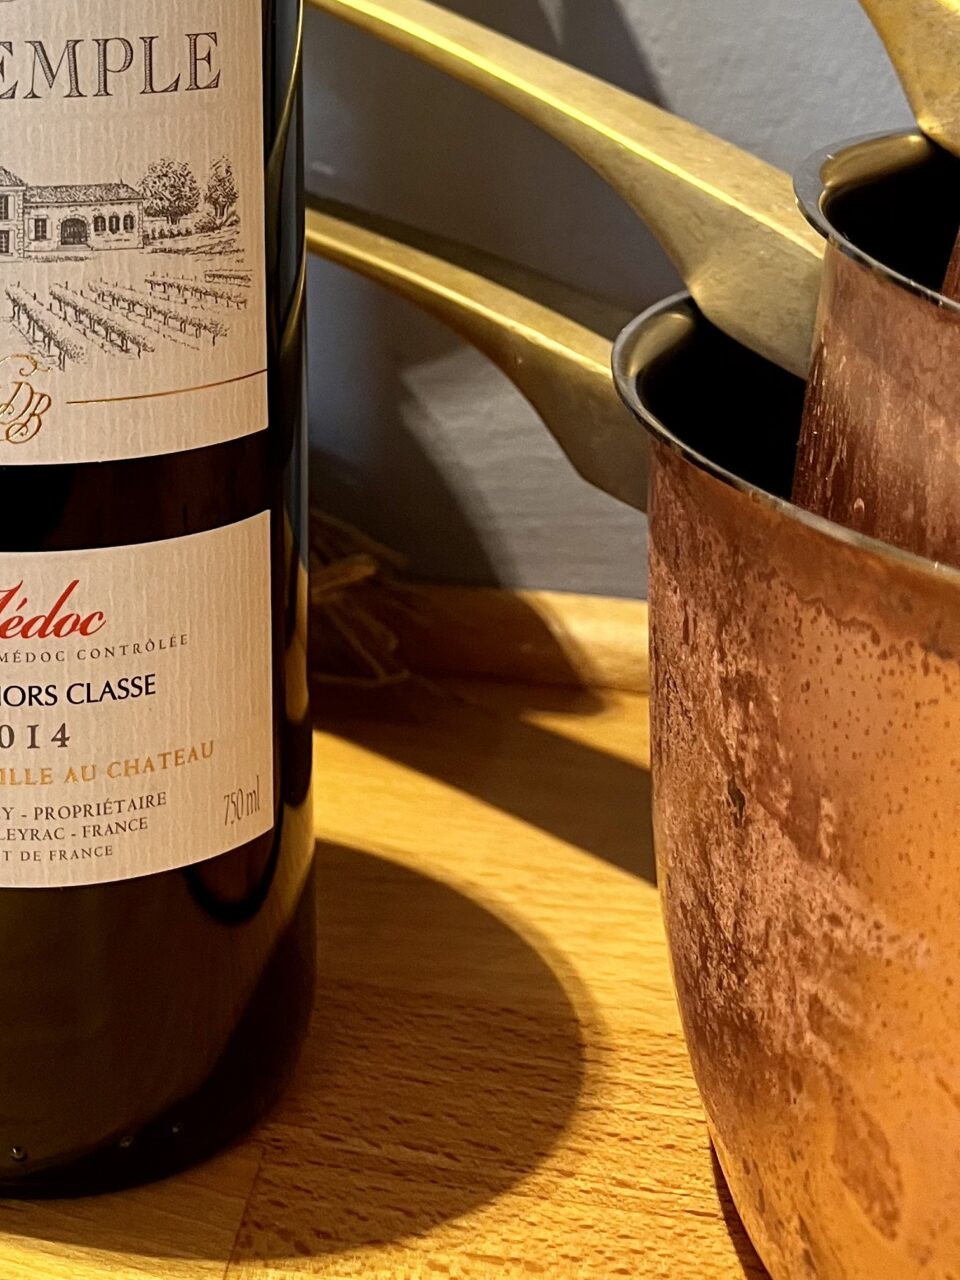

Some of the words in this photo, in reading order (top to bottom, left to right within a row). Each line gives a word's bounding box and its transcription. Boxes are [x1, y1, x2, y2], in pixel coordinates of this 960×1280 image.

[76, 633, 189, 661] CONTRÔLÉE
[66, 673, 157, 705] CLASSE
[63, 764, 97, 784] AU
[106, 739, 215, 780] CHATEAU
[34, 790, 167, 821] PROPRIÉTAIRE
[223, 786, 244, 826] 750
[246, 775, 261, 815] ml
[82, 817, 148, 839] FRANCE
[20, 851, 41, 862] DE
[49, 844, 113, 862] FRANCE
